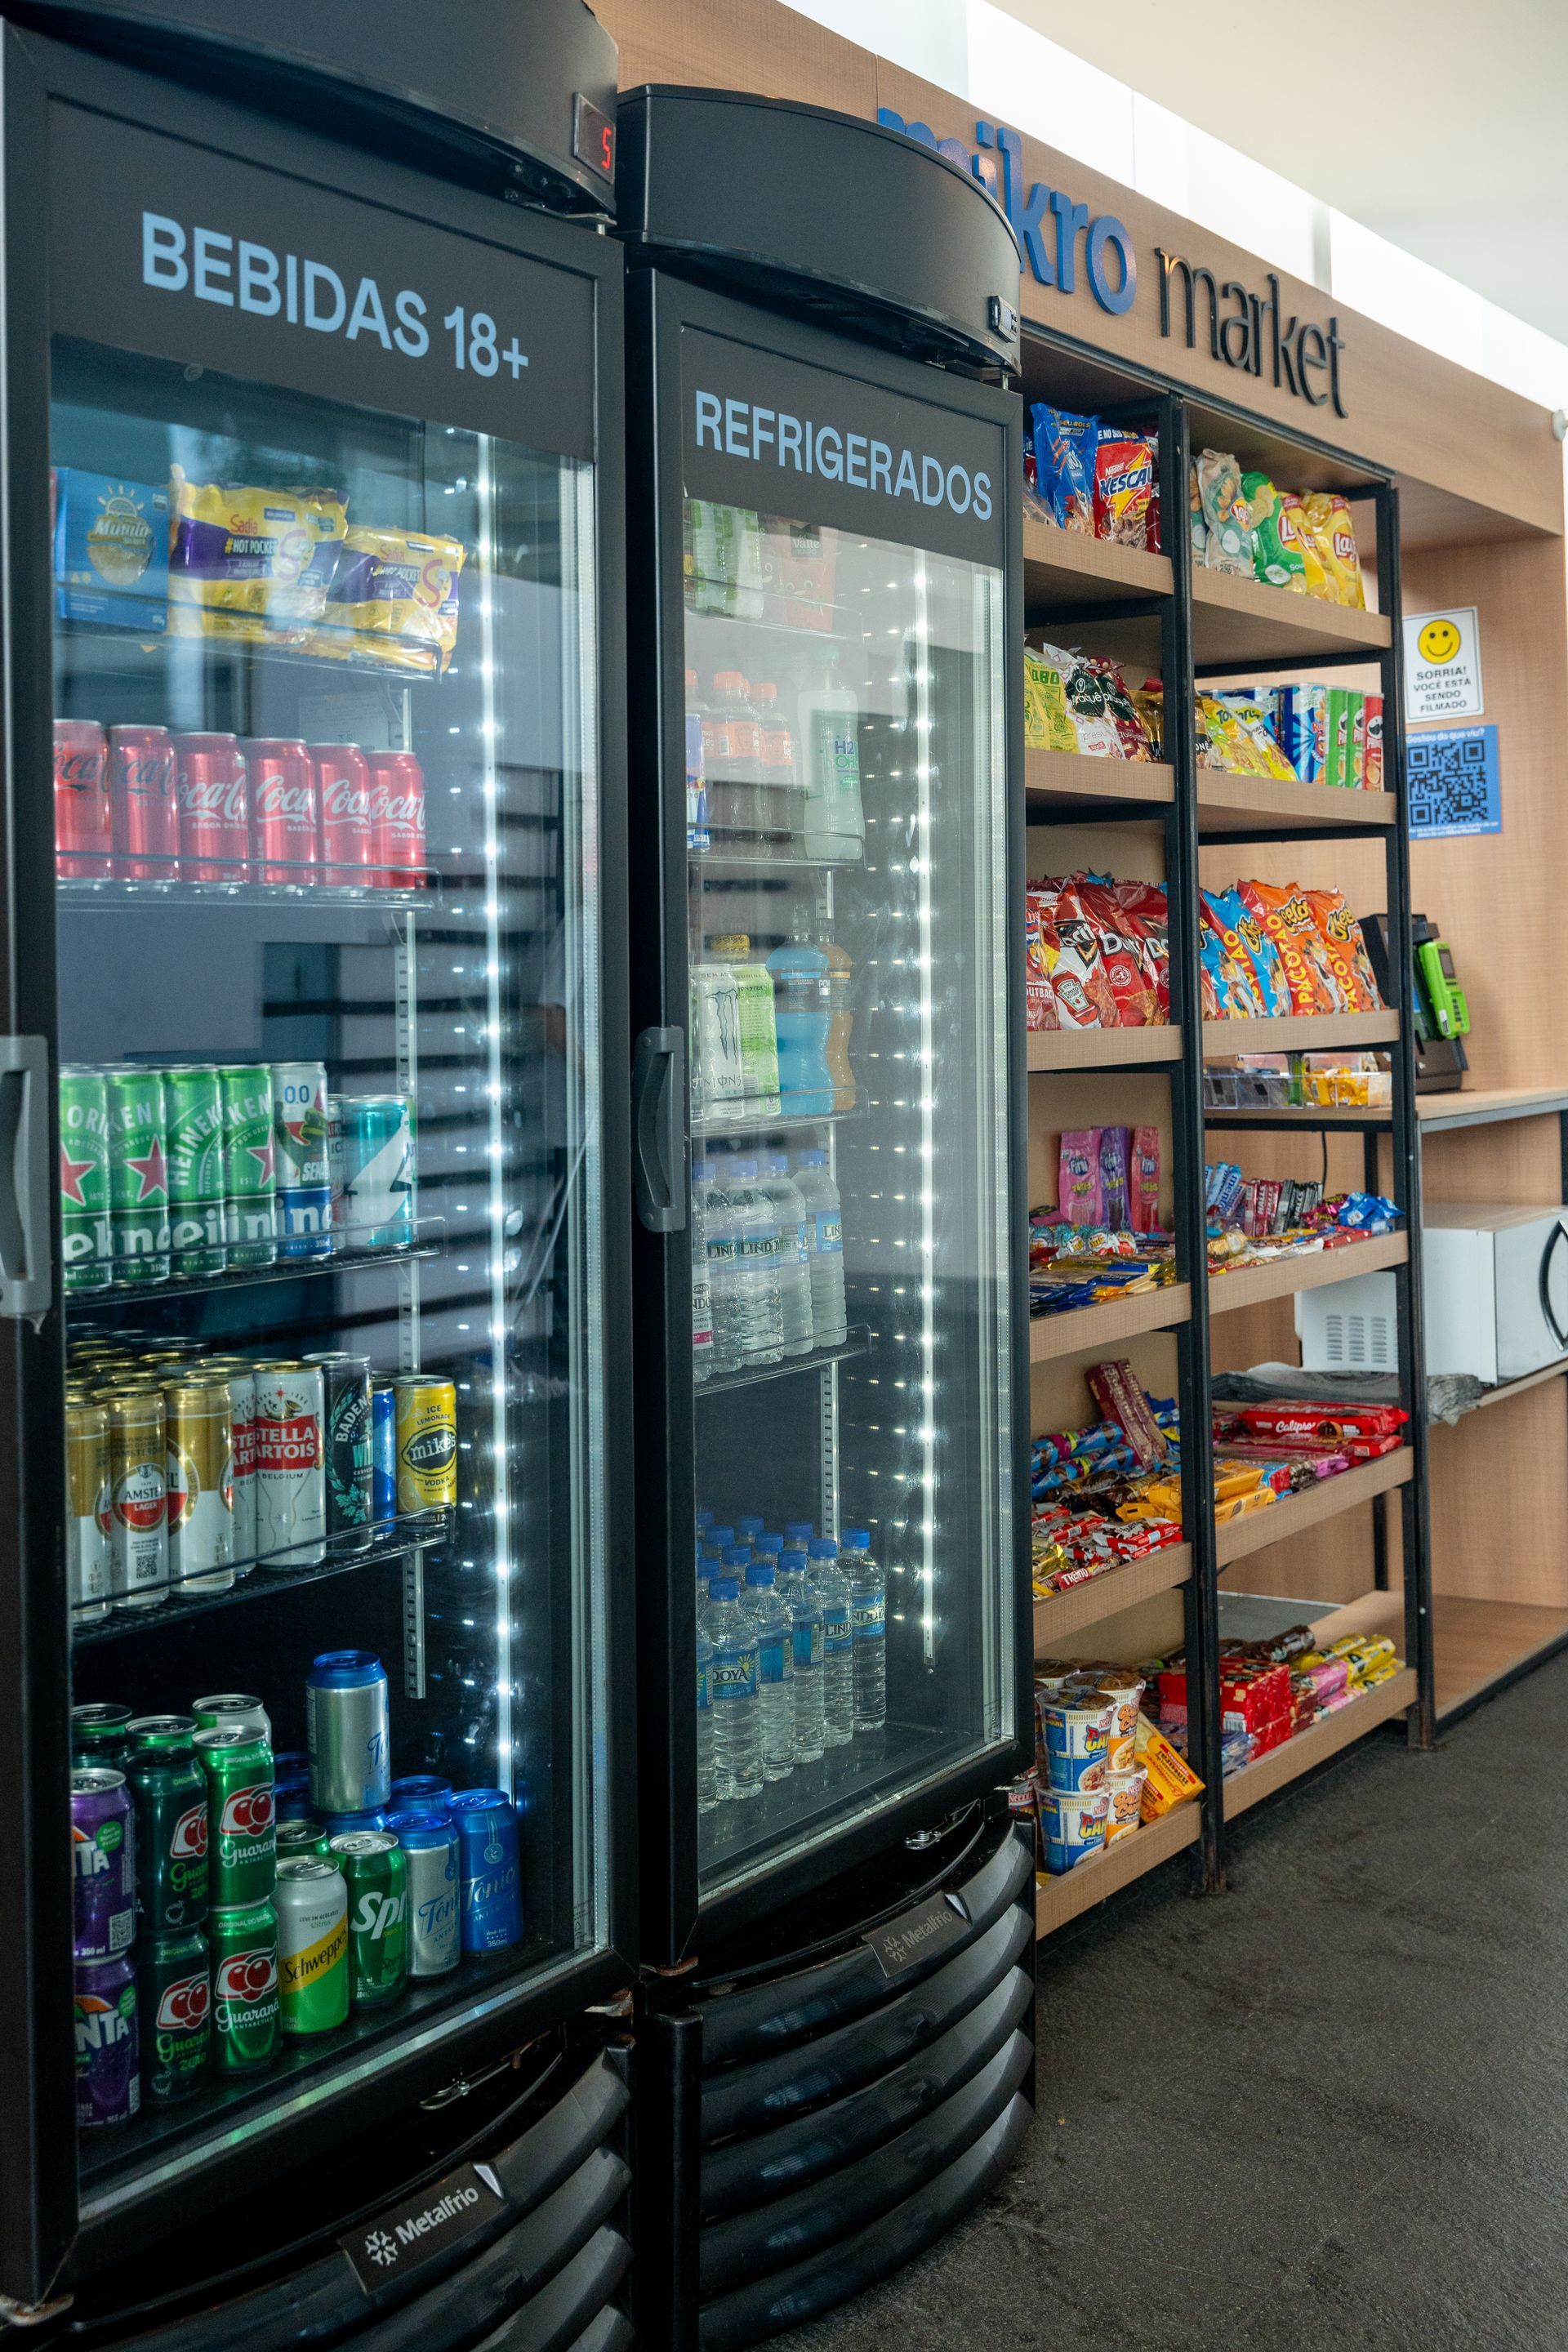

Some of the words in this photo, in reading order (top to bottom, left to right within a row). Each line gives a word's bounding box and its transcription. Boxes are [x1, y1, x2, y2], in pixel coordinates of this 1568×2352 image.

[601, 127, 612, 170] 5
[878, 107, 1138, 315] ikro
[1155, 247, 1349, 419] market
[141, 211, 430, 358] BEBIDAS
[444, 305, 529, 380] 18+
[694, 389, 993, 523] REFRIGERADOS
[1417, 666, 1466, 681] SORRIA!
[1413, 679, 1441, 692] VOCÊ
[1445, 677, 1471, 688] ESTÁ
[1425, 690, 1461, 702] SENDO
[1420, 700, 1467, 712] FILMADO
[284, 1085, 310, 1105] 0.0
[426, 1405, 442, 1414] ICE
[335, 1394, 369, 1443] BADEN
[416, 1414, 451, 1426] LEMONADE
[1276, 1419, 1316, 1434] Calipso
[262, 1472, 304, 1480] BELGIUM
[425, 1476, 450, 1487] VODKA
[134, 1501, 158, 1512] LAGER
[902, 1911, 953, 1949] Metalfrio
[215, 1998, 280, 2033] Guaraná
[395, 2187, 479, 2246] Metalfrio
